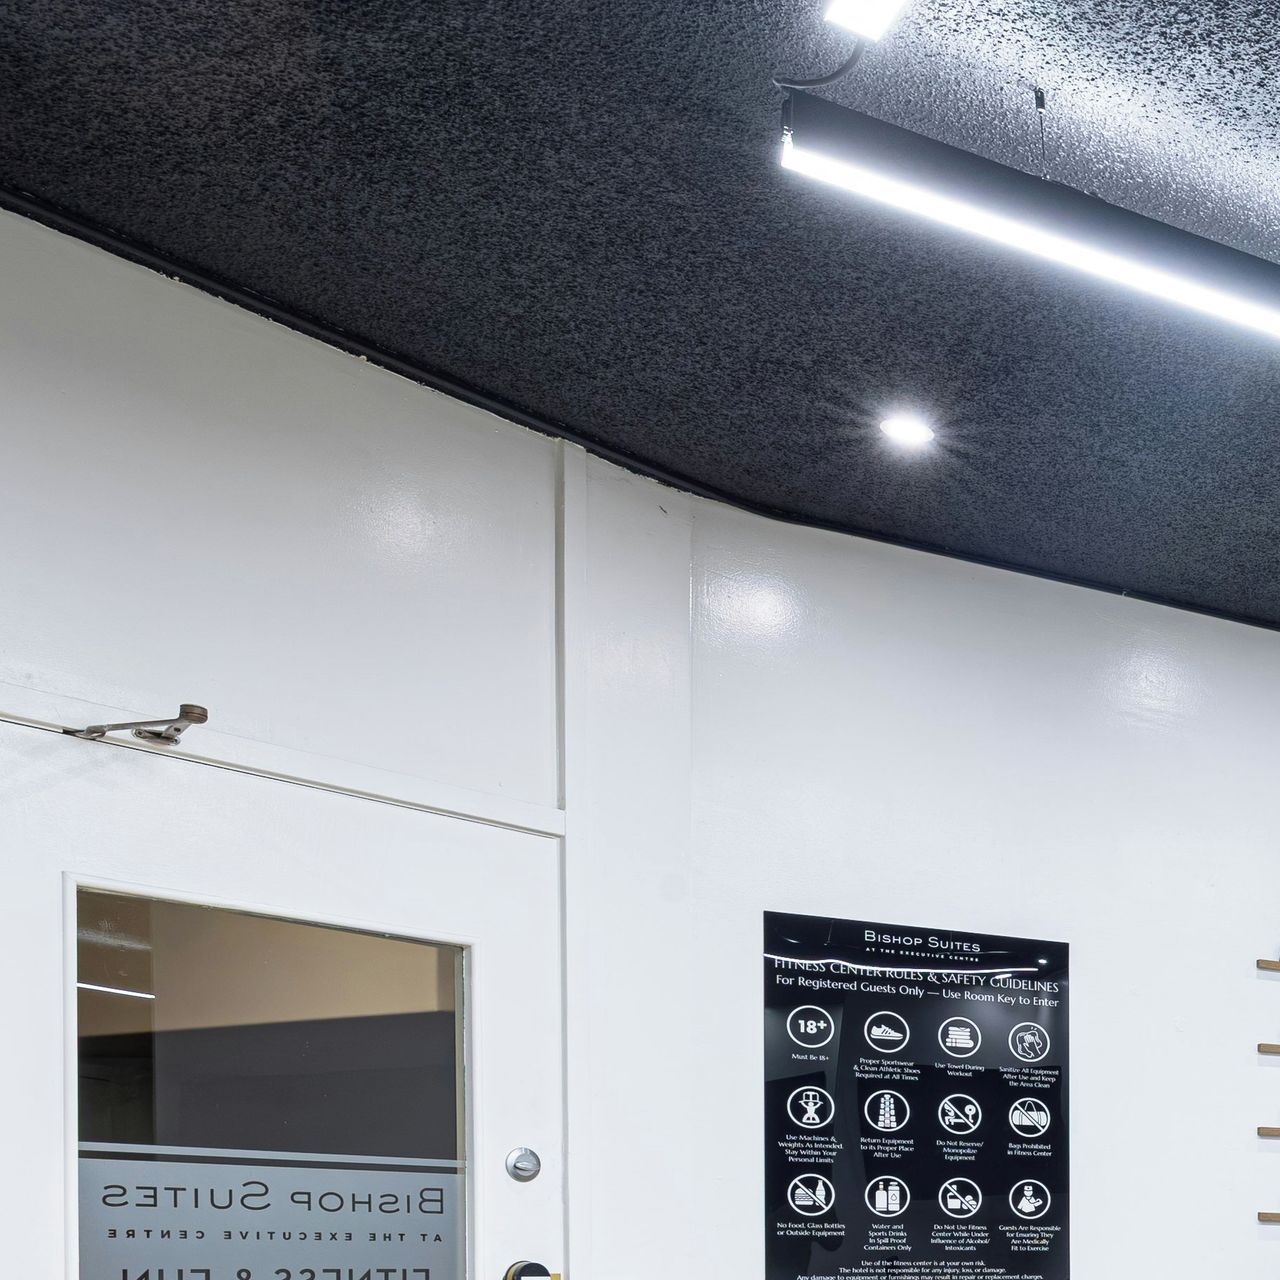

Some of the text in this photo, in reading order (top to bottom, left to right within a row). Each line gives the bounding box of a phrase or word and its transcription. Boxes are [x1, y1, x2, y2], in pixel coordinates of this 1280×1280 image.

[864, 930, 980, 952] BISHOP SUITES
[900, 951, 945, 959] EXECUTIVE
[775, 959, 1059, 992] FITNESS CENTER RULES & SAFETY GUIDELINES
[776, 975, 795, 985] For
[798, 977, 857, 990] Registered
[860, 982, 896, 994] Guests
[900, 985, 924, 998] Only
[942, 989, 961, 999] Use
[964, 991, 994, 1002] Room
[998, 994, 1016, 1006] Key
[1019, 996, 1030, 1004] to
[1033, 997, 1059, 1007] Enter
[798, 1020, 827, 1034] 18+
[965, 1064, 985, 1072] During
[1030, 1068, 1059, 1076] Equipment
[855, 1072, 883, 1080] Required
[778, 1141, 804, 1149] Weights
[942, 1147, 978, 1155] Monopolize
